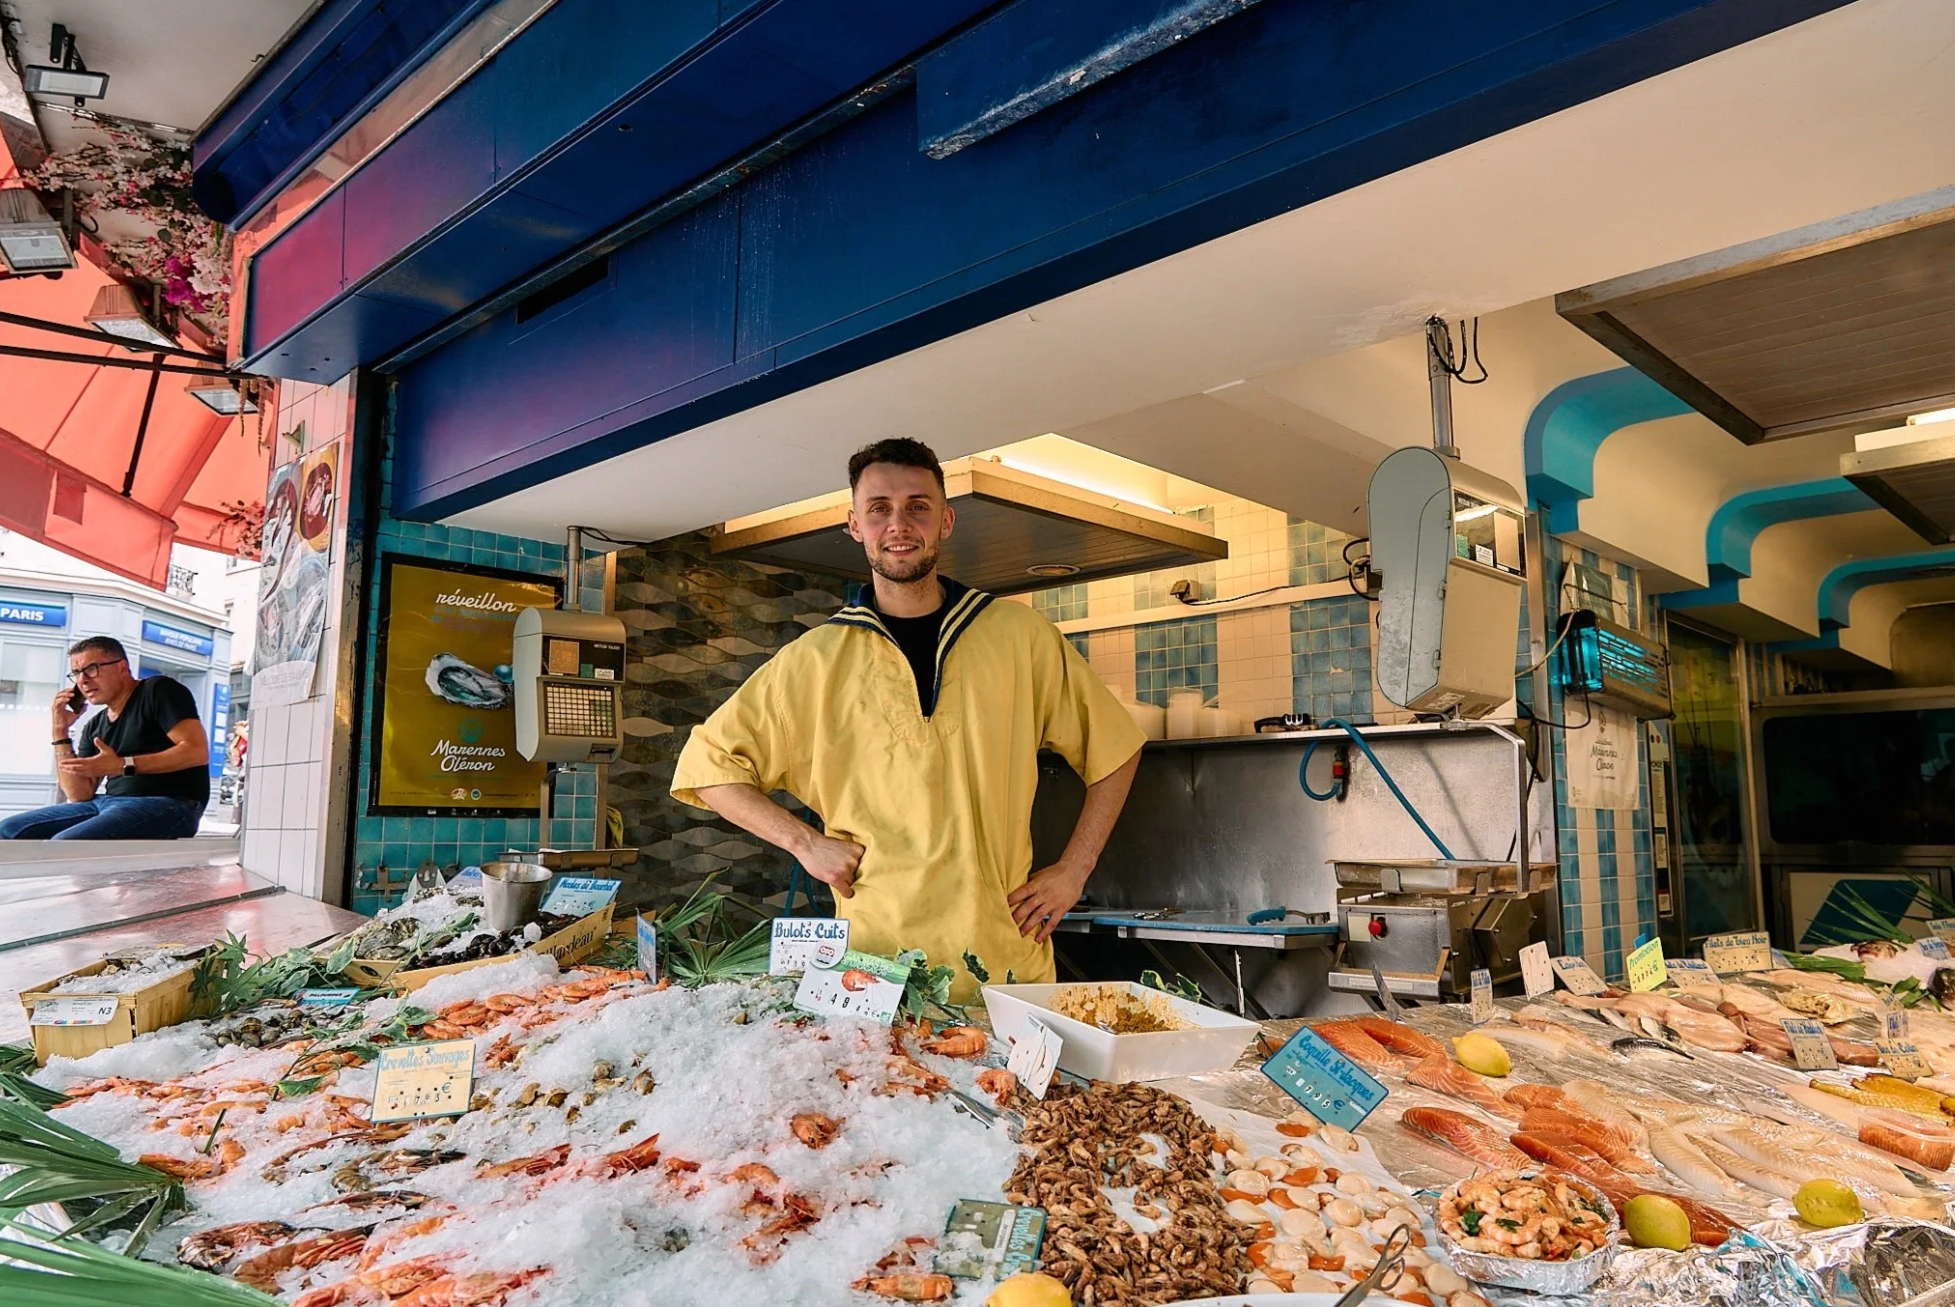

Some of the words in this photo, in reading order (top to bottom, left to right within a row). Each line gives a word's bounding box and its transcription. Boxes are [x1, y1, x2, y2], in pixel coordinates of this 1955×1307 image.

[435, 588, 517, 612] réveillon
[0, 607, 44, 621] PARIS
[430, 739, 505, 757] Marennes
[440, 755, 495, 772] Oléron
[815, 922, 845, 939] Cuits
[380, 1048, 423, 1071] Crevettes
[1299, 1035, 1331, 1066] Coquille
[1009, 1208, 1042, 1250] Crevettes
